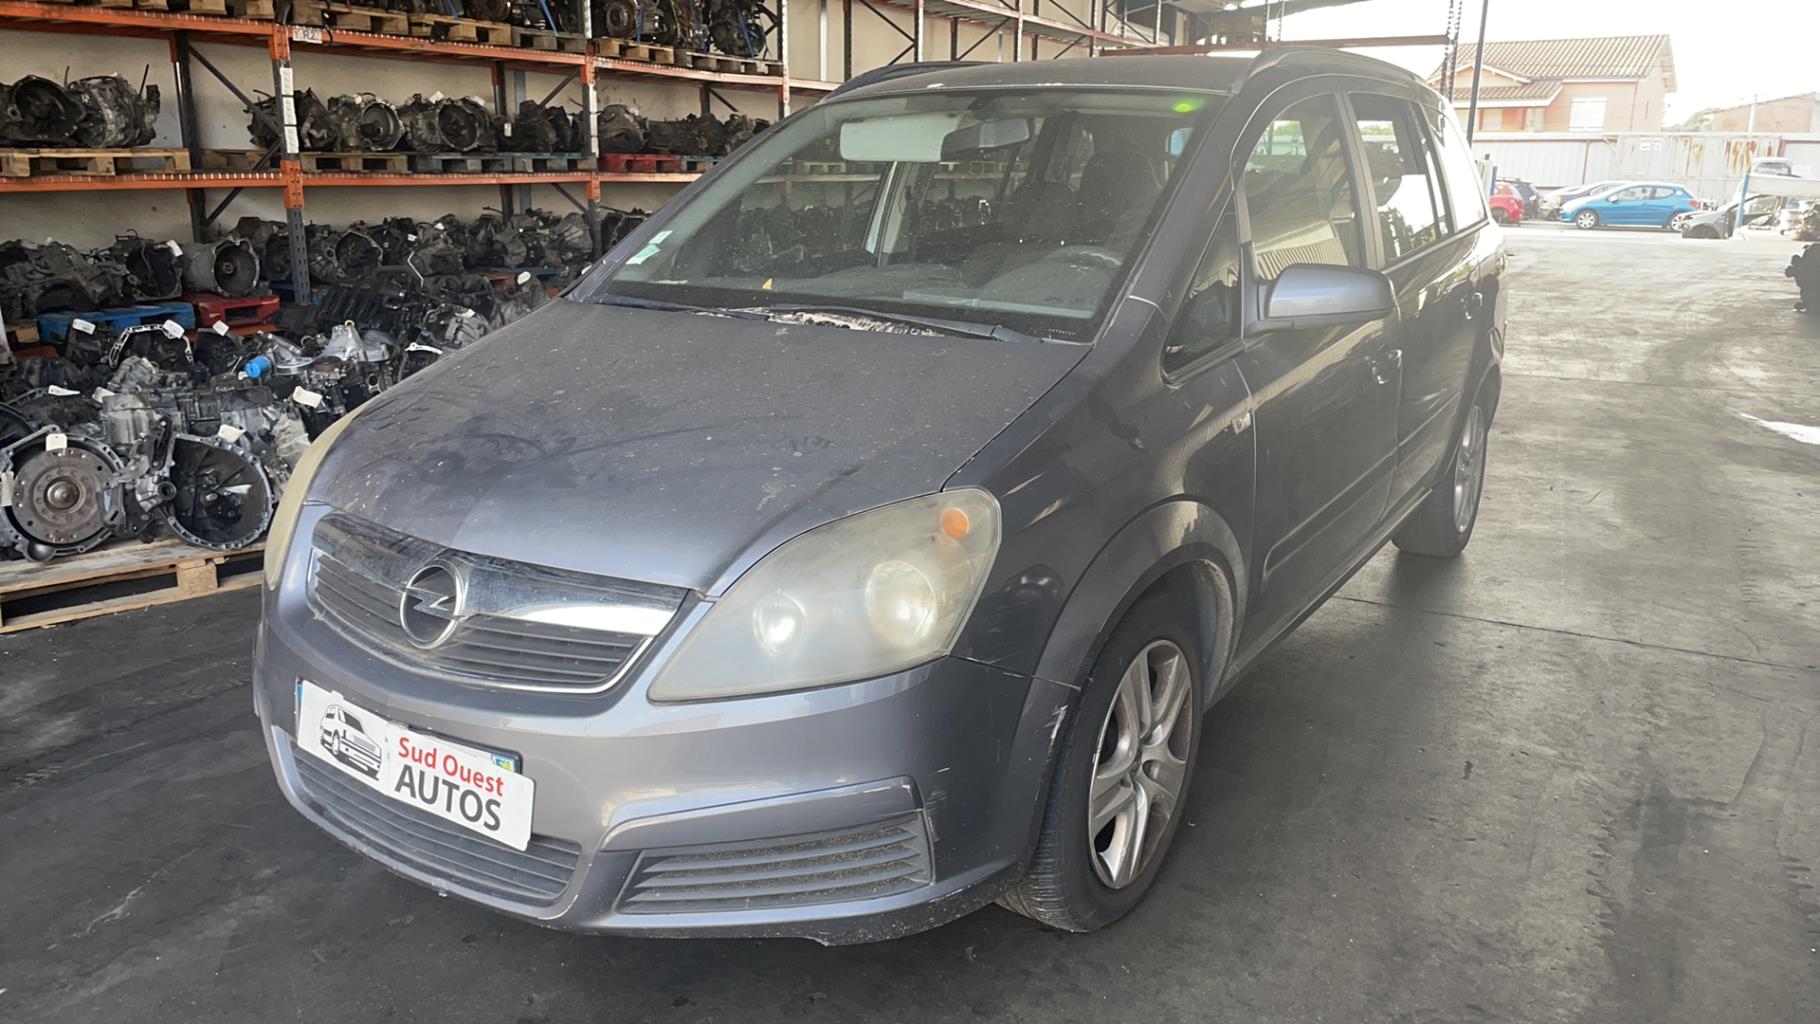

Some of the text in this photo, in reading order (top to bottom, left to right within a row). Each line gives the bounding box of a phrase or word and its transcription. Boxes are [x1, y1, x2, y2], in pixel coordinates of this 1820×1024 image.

[394, 764, 501, 831] AUTOS
[398, 737, 504, 797] Sud Ouest
